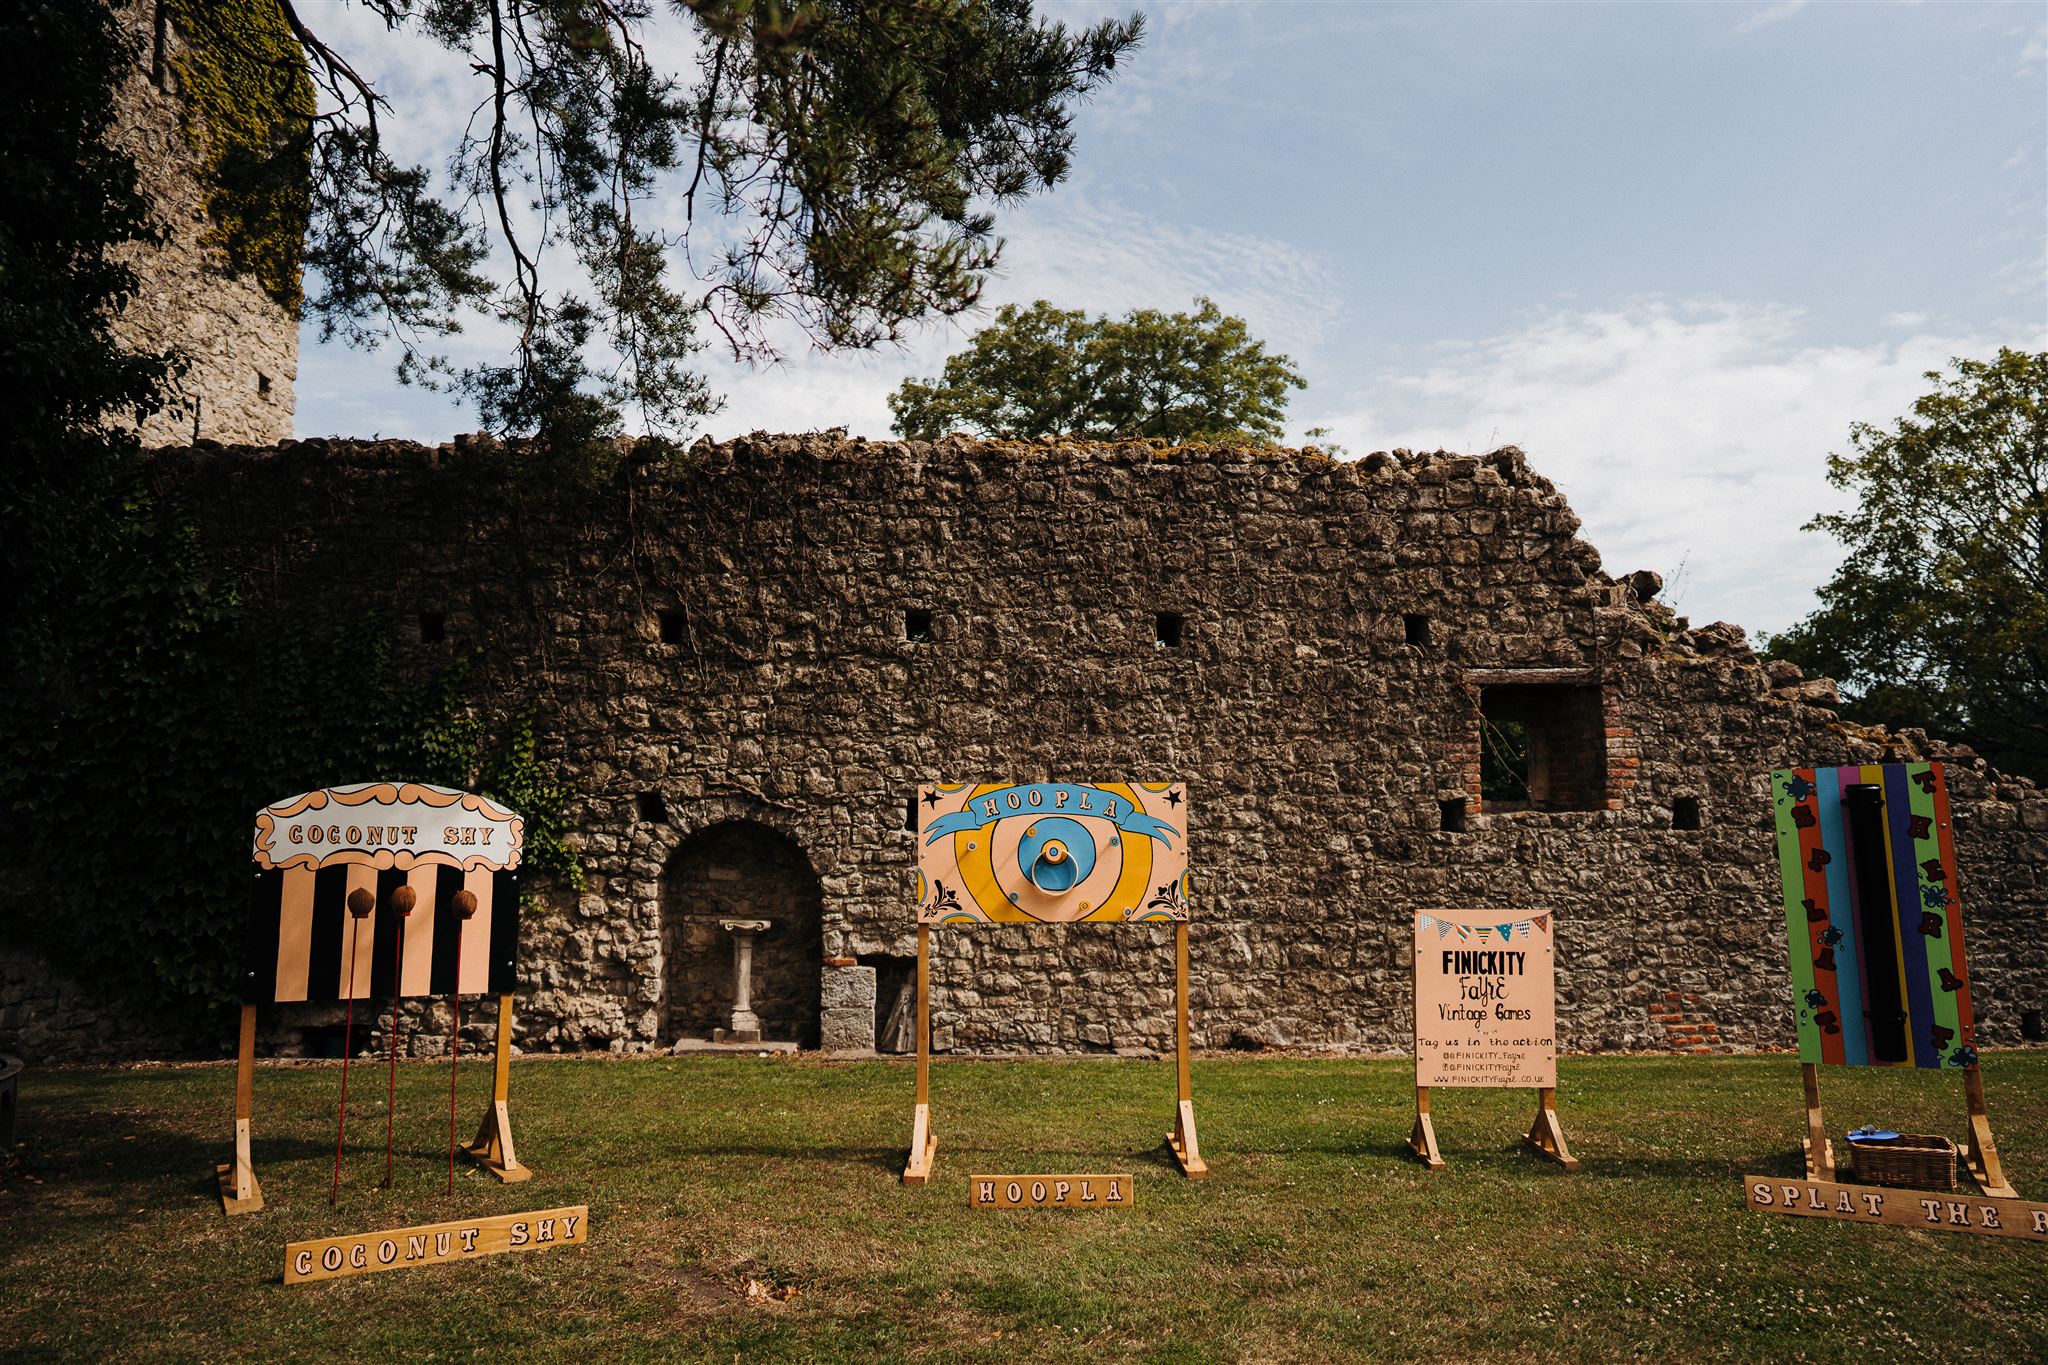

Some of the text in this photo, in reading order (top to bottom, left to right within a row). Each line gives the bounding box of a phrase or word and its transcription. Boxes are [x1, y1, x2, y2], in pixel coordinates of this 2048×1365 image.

[982, 789, 1117, 818] HOOPLA
[289, 825, 495, 845] COCONUT SHY
[1442, 950, 1526, 976] FINICKITY
[1438, 1002, 1531, 1029] Vintage Games
[1418, 1037, 1553, 1049] Tag us in the action
[978, 1180, 1123, 1203] HOOPLA
[1752, 1183, 1884, 1216] SPLAT
[1920, 1199, 2001, 1229] THE
[294, 1216, 579, 1275] COCONUT SHY
